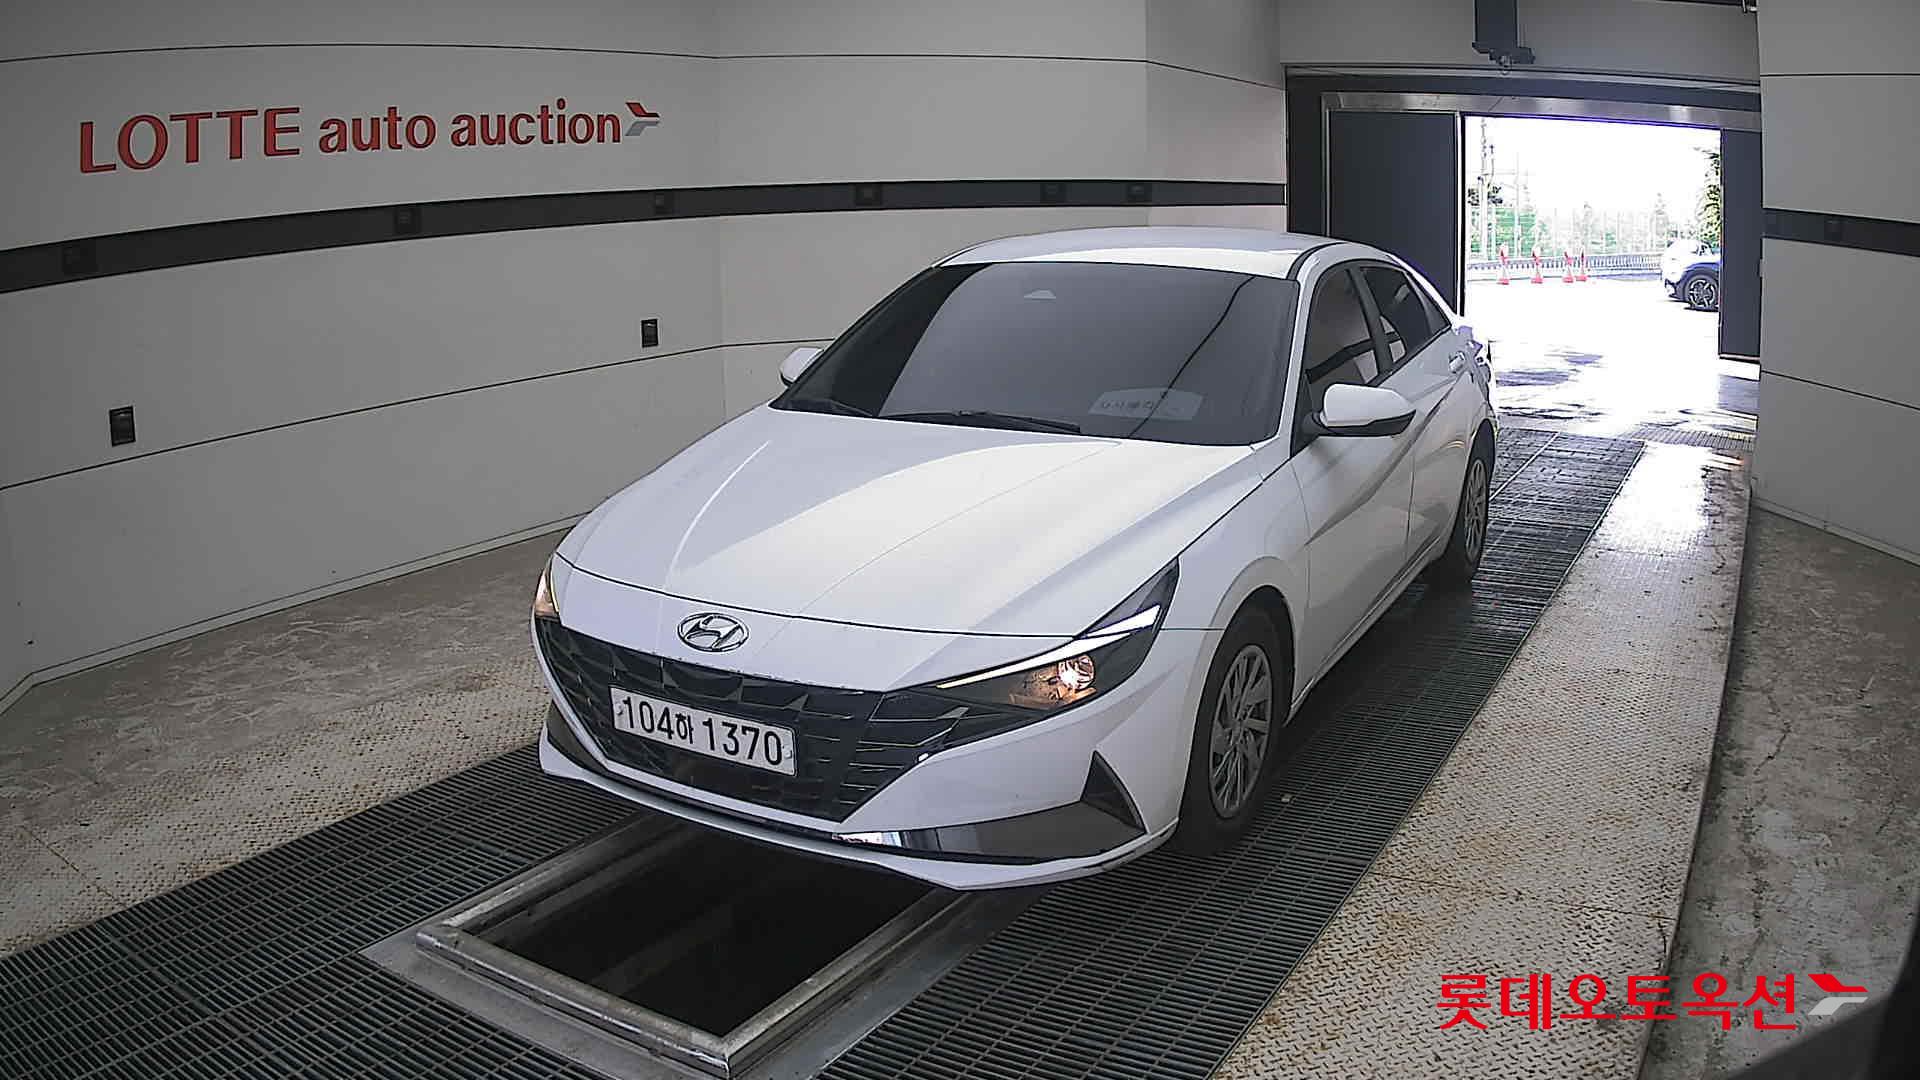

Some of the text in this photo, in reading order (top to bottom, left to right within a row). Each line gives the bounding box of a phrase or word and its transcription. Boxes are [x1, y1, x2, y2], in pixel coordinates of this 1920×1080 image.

[80, 98, 622, 173] LOTTE auto auction
[622, 696, 783, 766] 104하 1370
